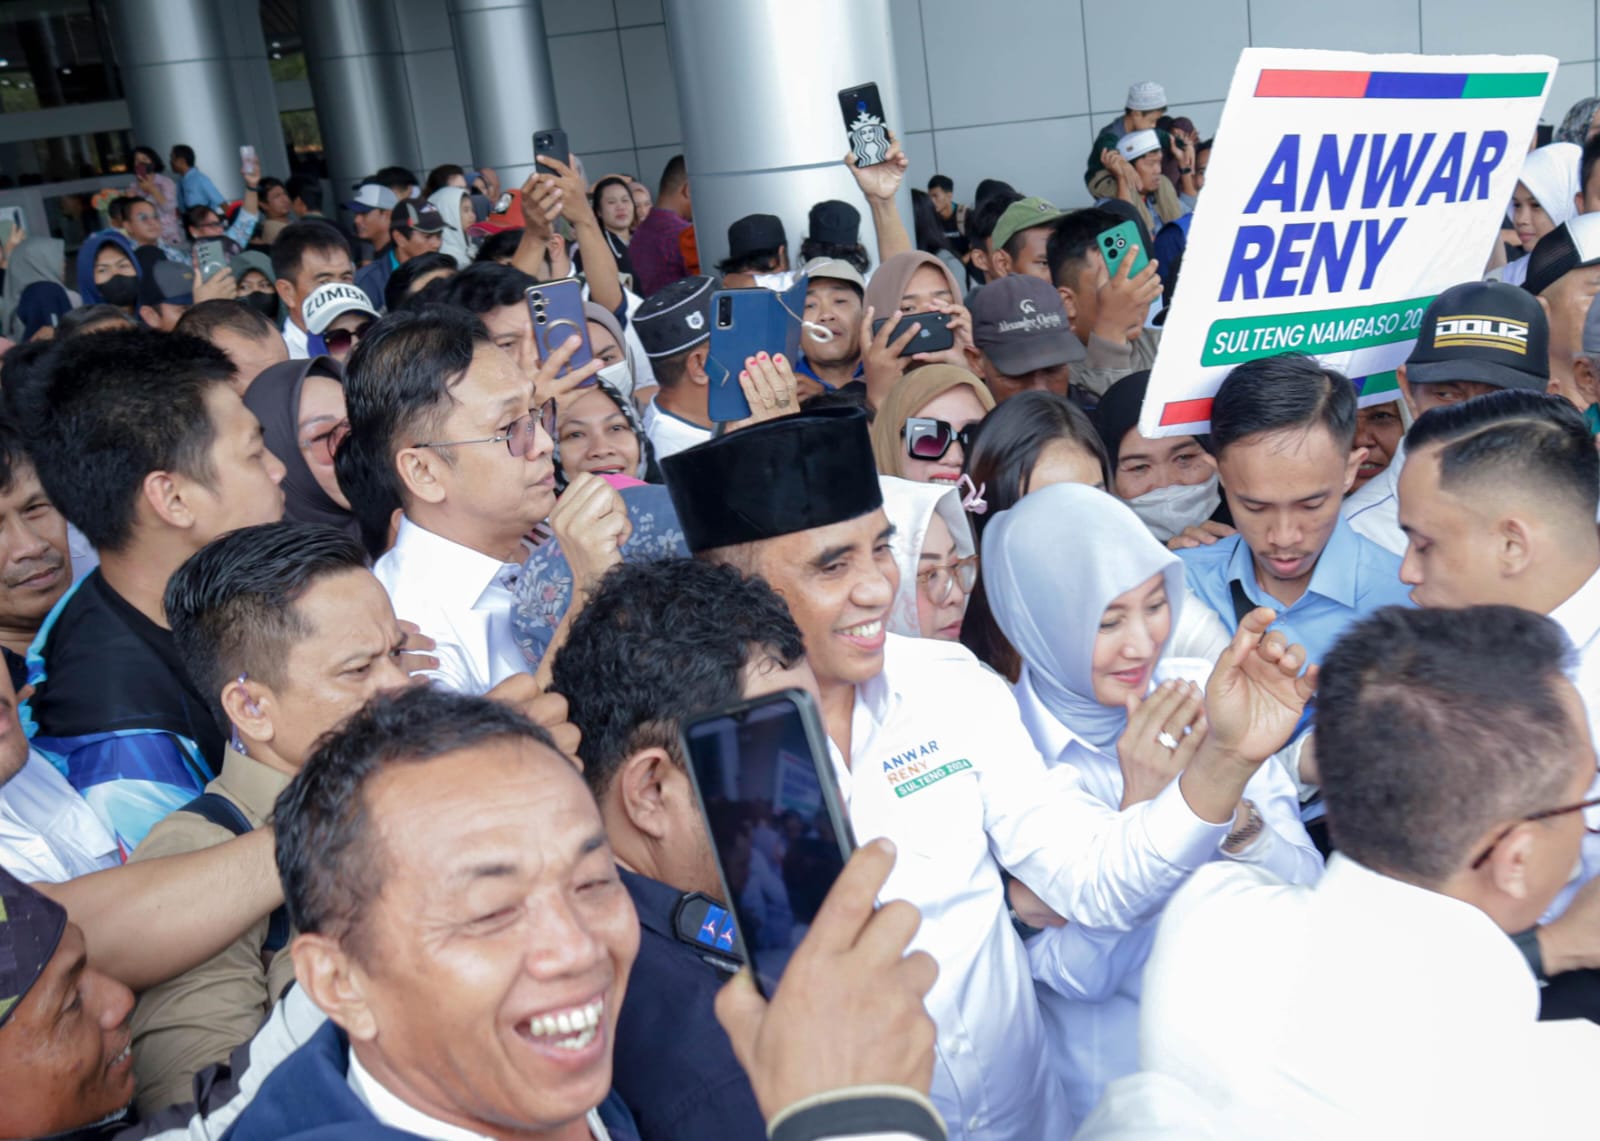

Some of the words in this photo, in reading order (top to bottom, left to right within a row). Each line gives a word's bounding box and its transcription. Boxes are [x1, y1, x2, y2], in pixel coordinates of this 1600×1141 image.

[1242, 130, 1508, 214] ANWAR
[1218, 217, 1408, 302] RENY
[1212, 324, 1305, 355] SULTENG
[1307, 312, 1400, 346] NAMBASO
[1400, 307, 1424, 332] 20
[882, 740, 939, 773] ANWAR
[886, 760, 928, 785] RENY
[898, 768, 947, 796] SULTENG
